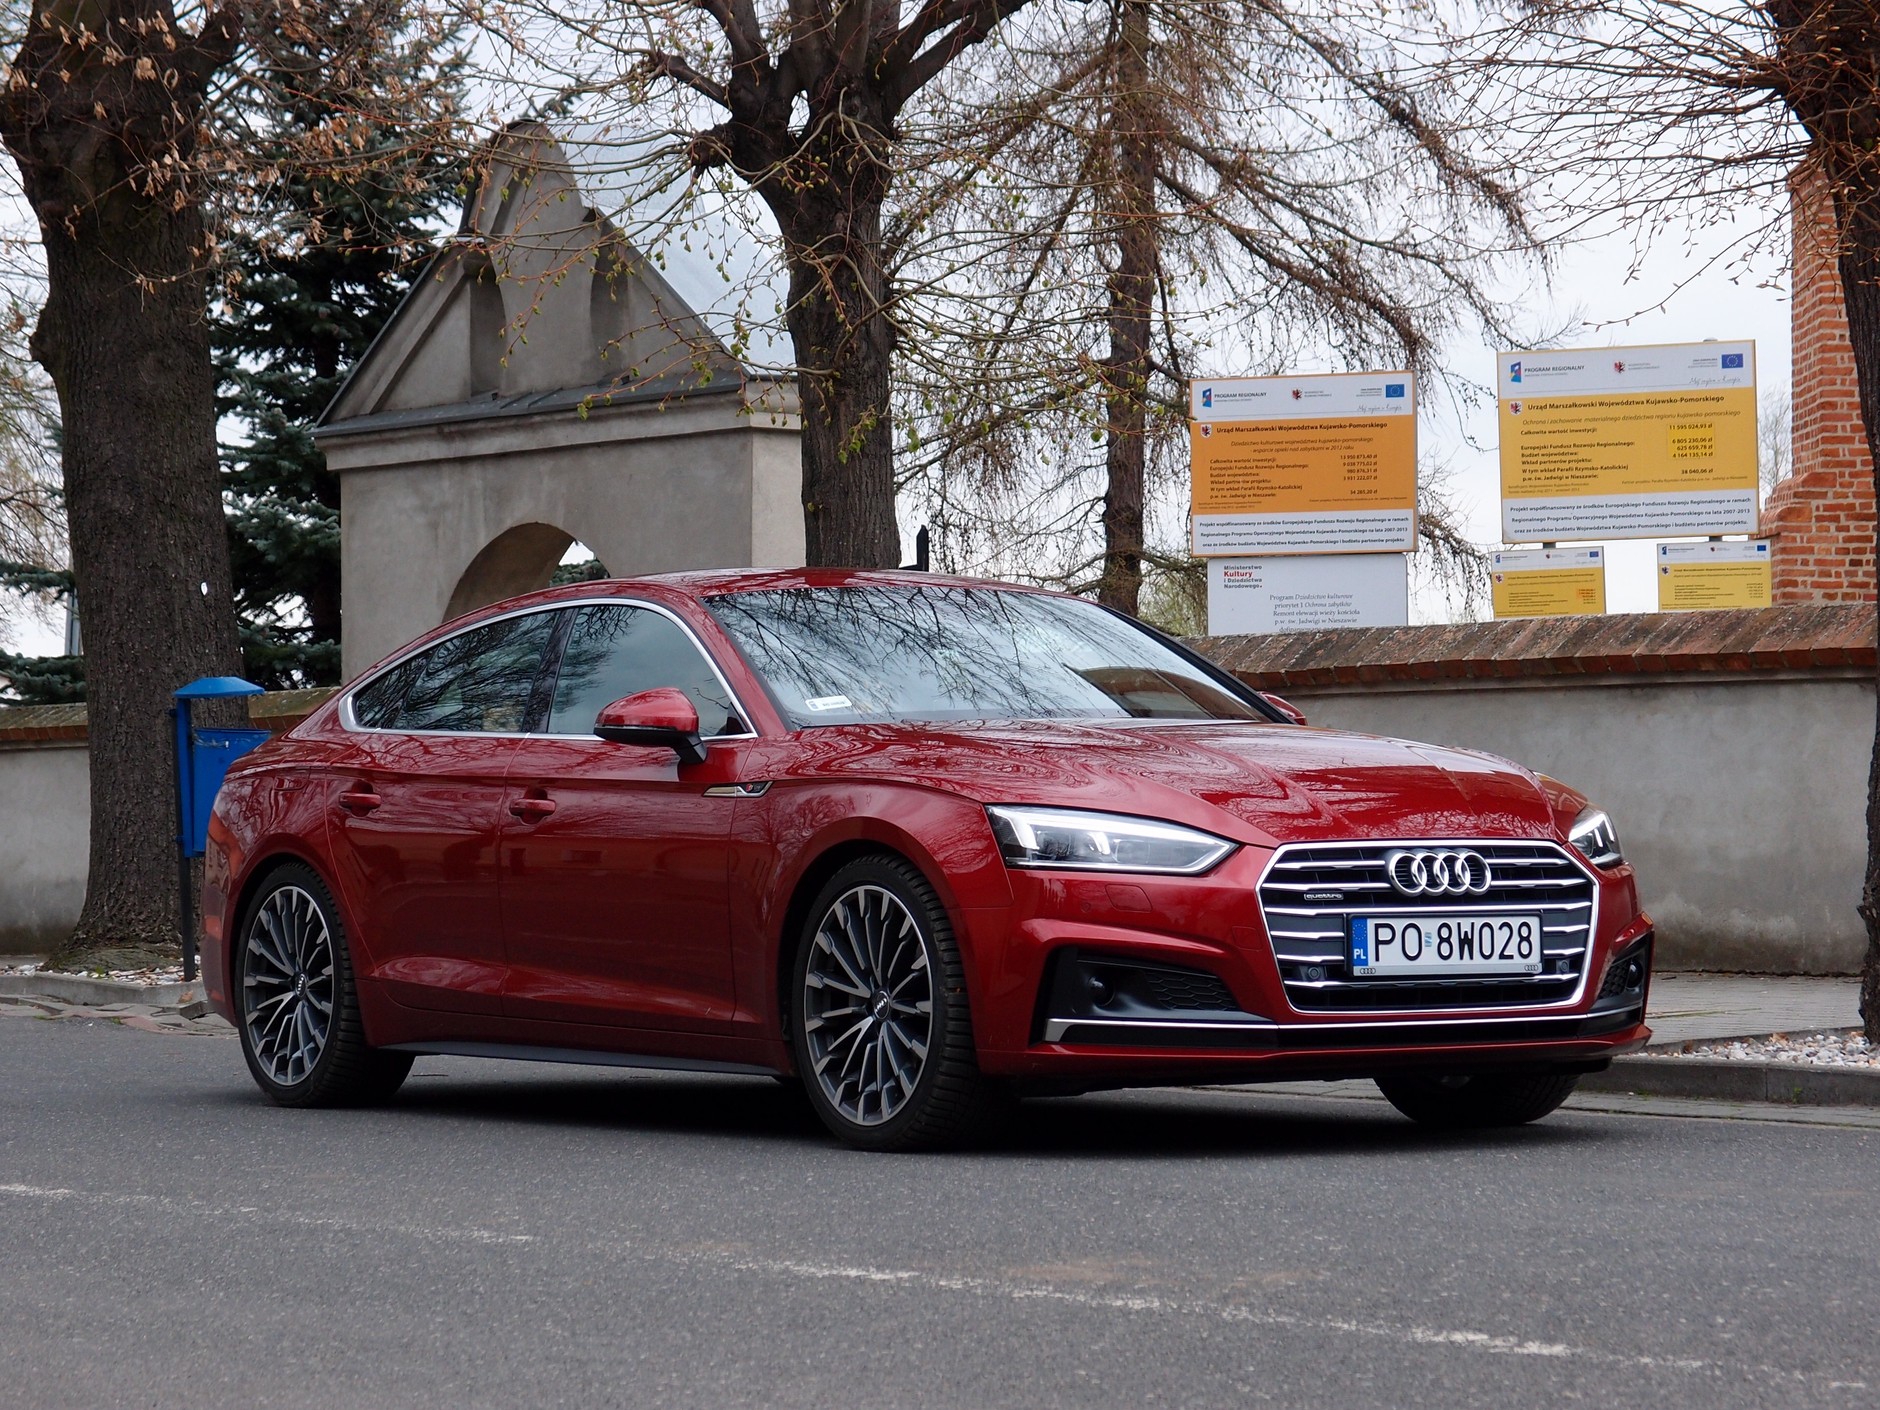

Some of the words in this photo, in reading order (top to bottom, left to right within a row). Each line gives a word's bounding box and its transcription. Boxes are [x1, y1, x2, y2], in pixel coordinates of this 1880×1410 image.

[1548, 401, 1597, 410] Marszałkowski
[1598, 400, 1644, 408] Województwa
[1646, 396, 1724, 406] Kujawsko-Pomorskiego
[1622, 413, 1654, 421] dziedzictwa
[1677, 410, 1740, 419] kujawsko-pomorskiego
[1320, 422, 1388, 430] Kujawsko-Pomorskiego
[1575, 464, 1628, 472] Rzymsko-Katolickiej
[1354, 949, 1366, 960] PL
[1374, 922, 1423, 962] PO
[1436, 921, 1533, 961] 8W028
